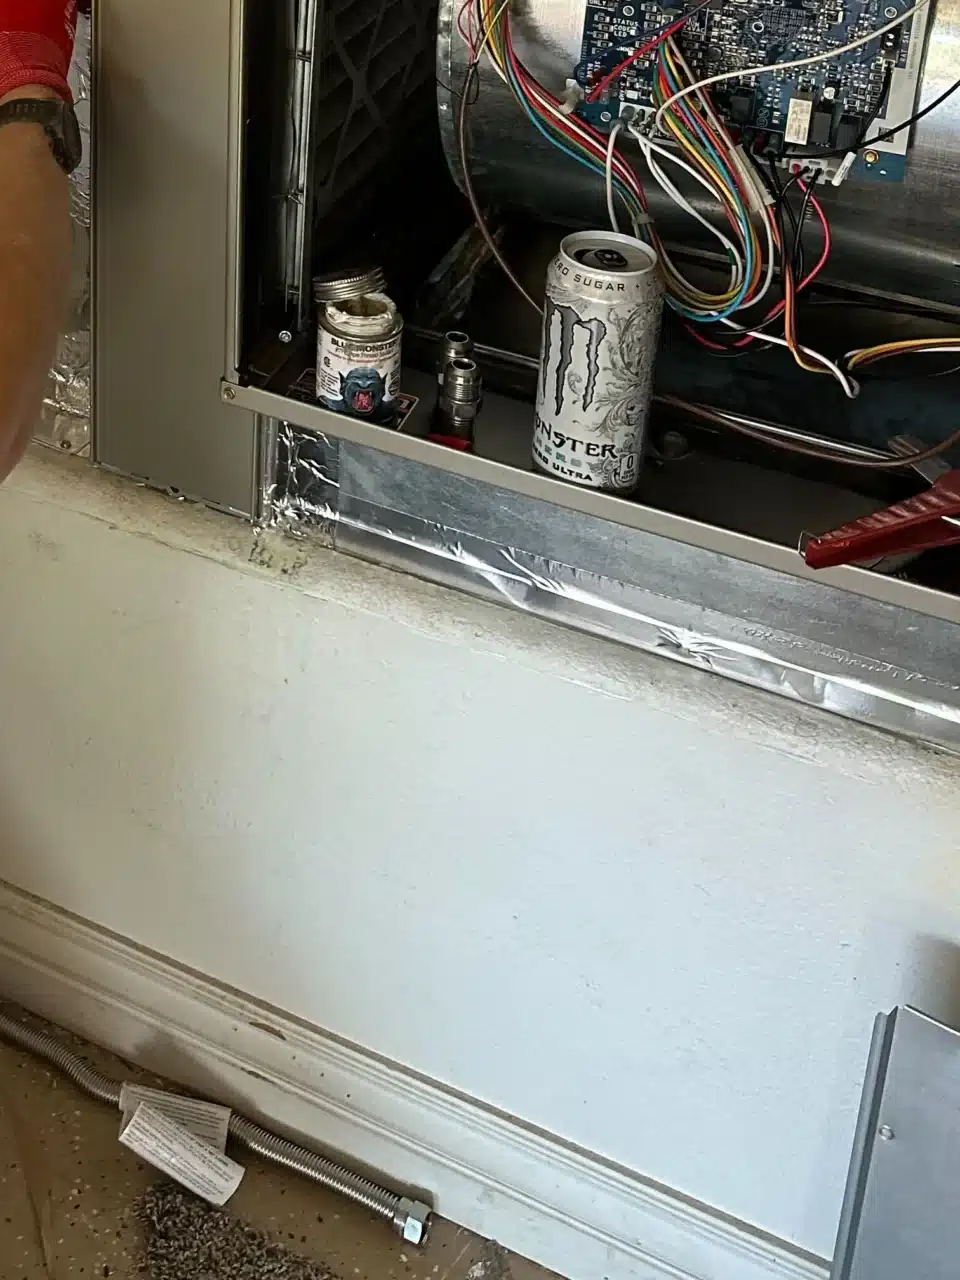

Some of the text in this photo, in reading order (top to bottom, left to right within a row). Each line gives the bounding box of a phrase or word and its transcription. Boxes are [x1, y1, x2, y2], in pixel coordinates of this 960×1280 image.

[613, 18, 638, 26] STATUS
[574, 274, 625, 291] SUGAR
[552, 462, 593, 481] ULTRA
